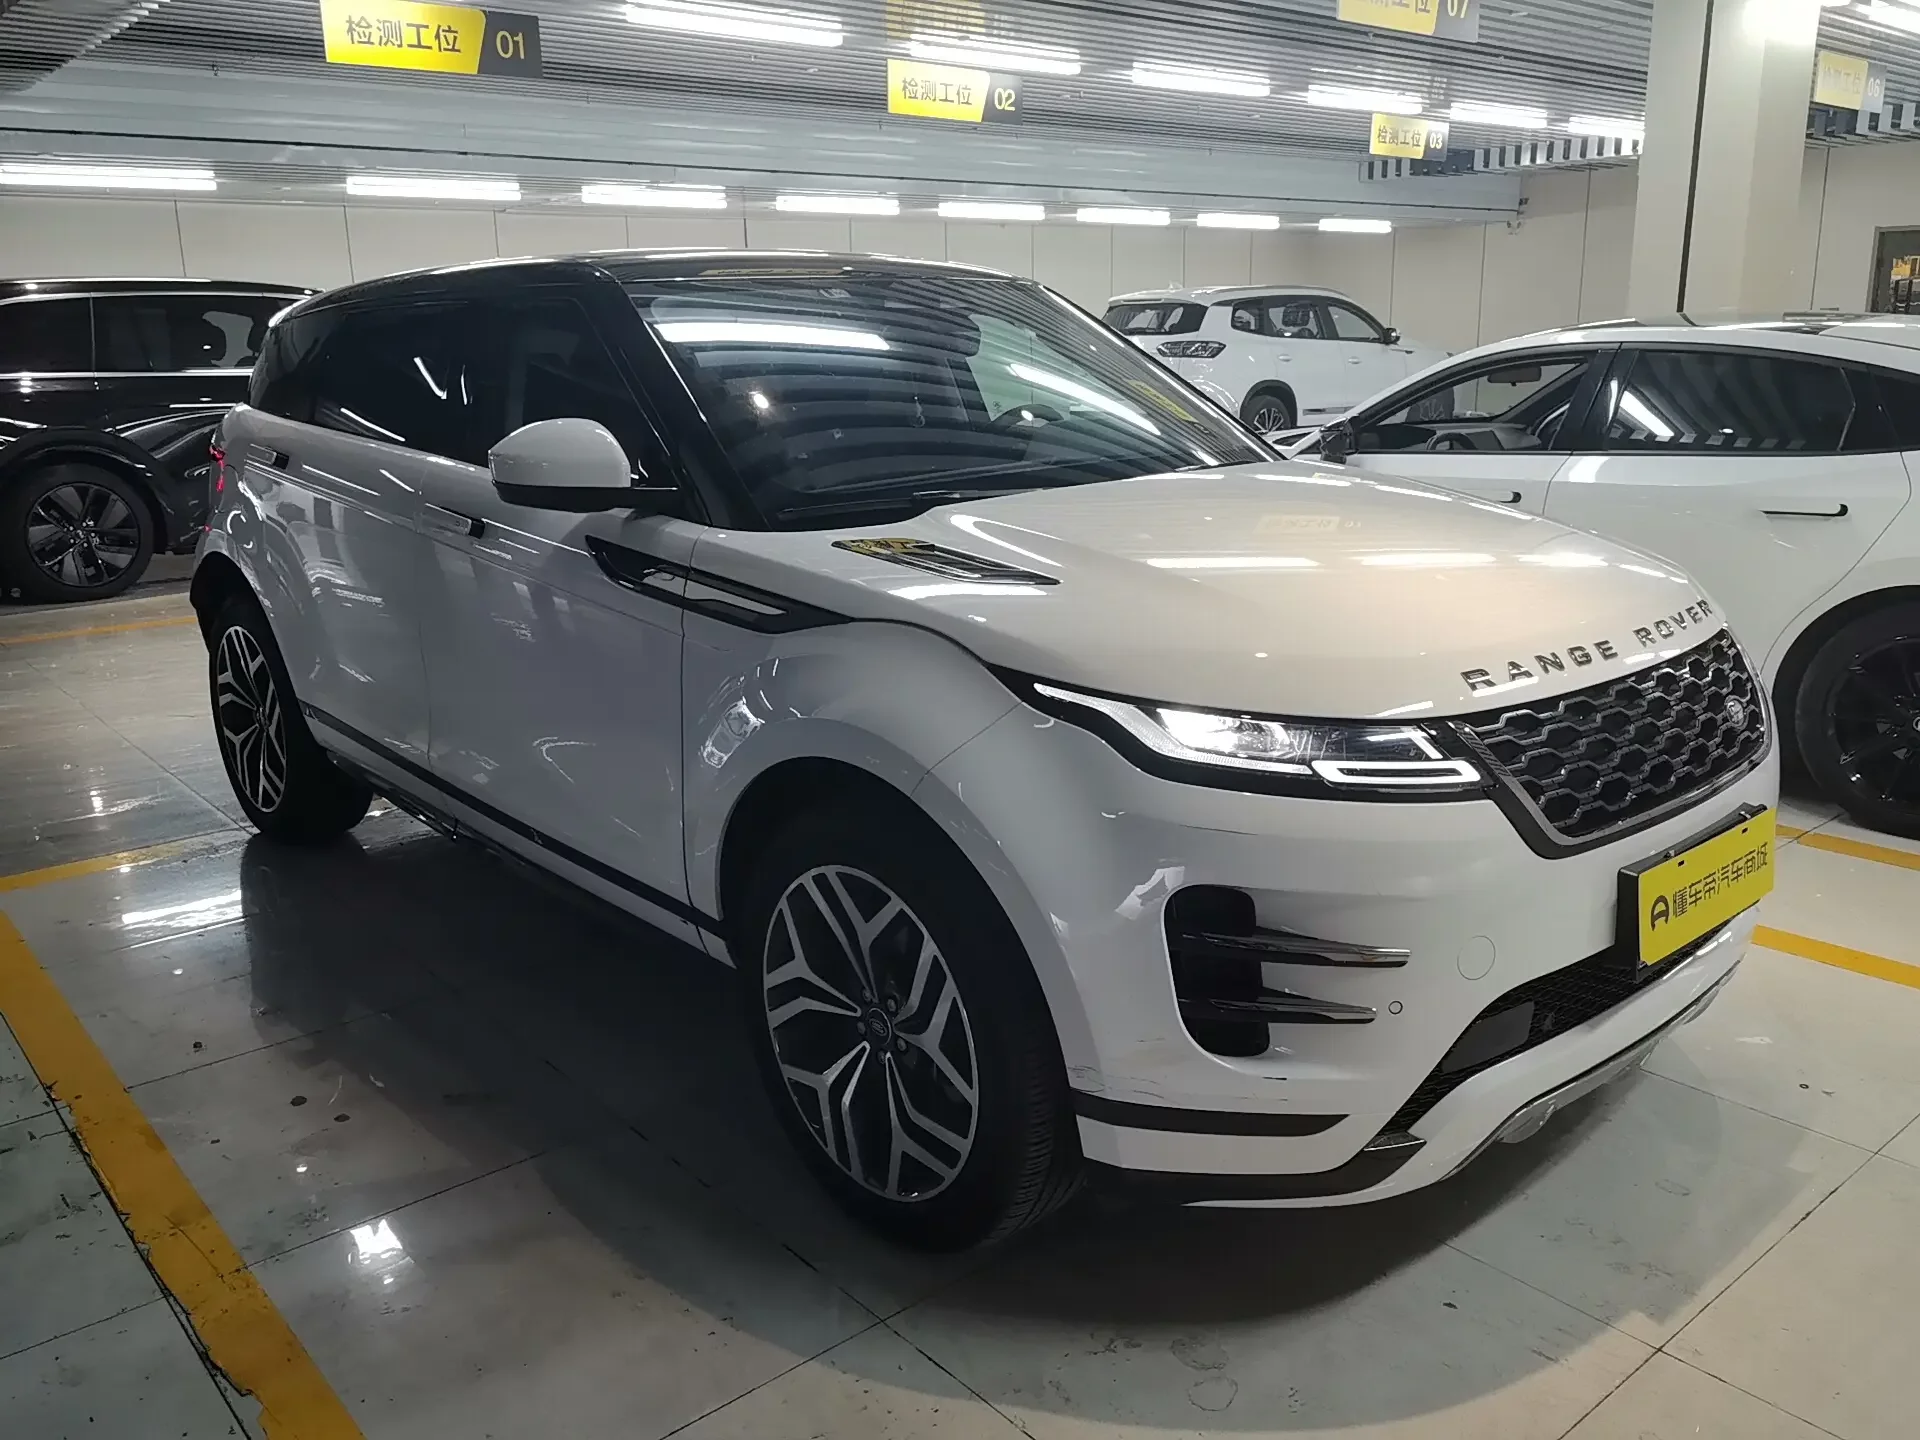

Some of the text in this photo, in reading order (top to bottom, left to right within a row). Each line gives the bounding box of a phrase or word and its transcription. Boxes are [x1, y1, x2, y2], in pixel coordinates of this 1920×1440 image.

[346, 15, 525, 59] 检测工位 01
[902, 77, 1016, 111] 检测工位 02
[1867, 77, 1881, 98] 06
[1377, 124, 1443, 149] 检测工位 03
[1460, 598, 1714, 692] RANGE ROVER
[1672, 842, 1769, 918] 懂车帝汽车商城
